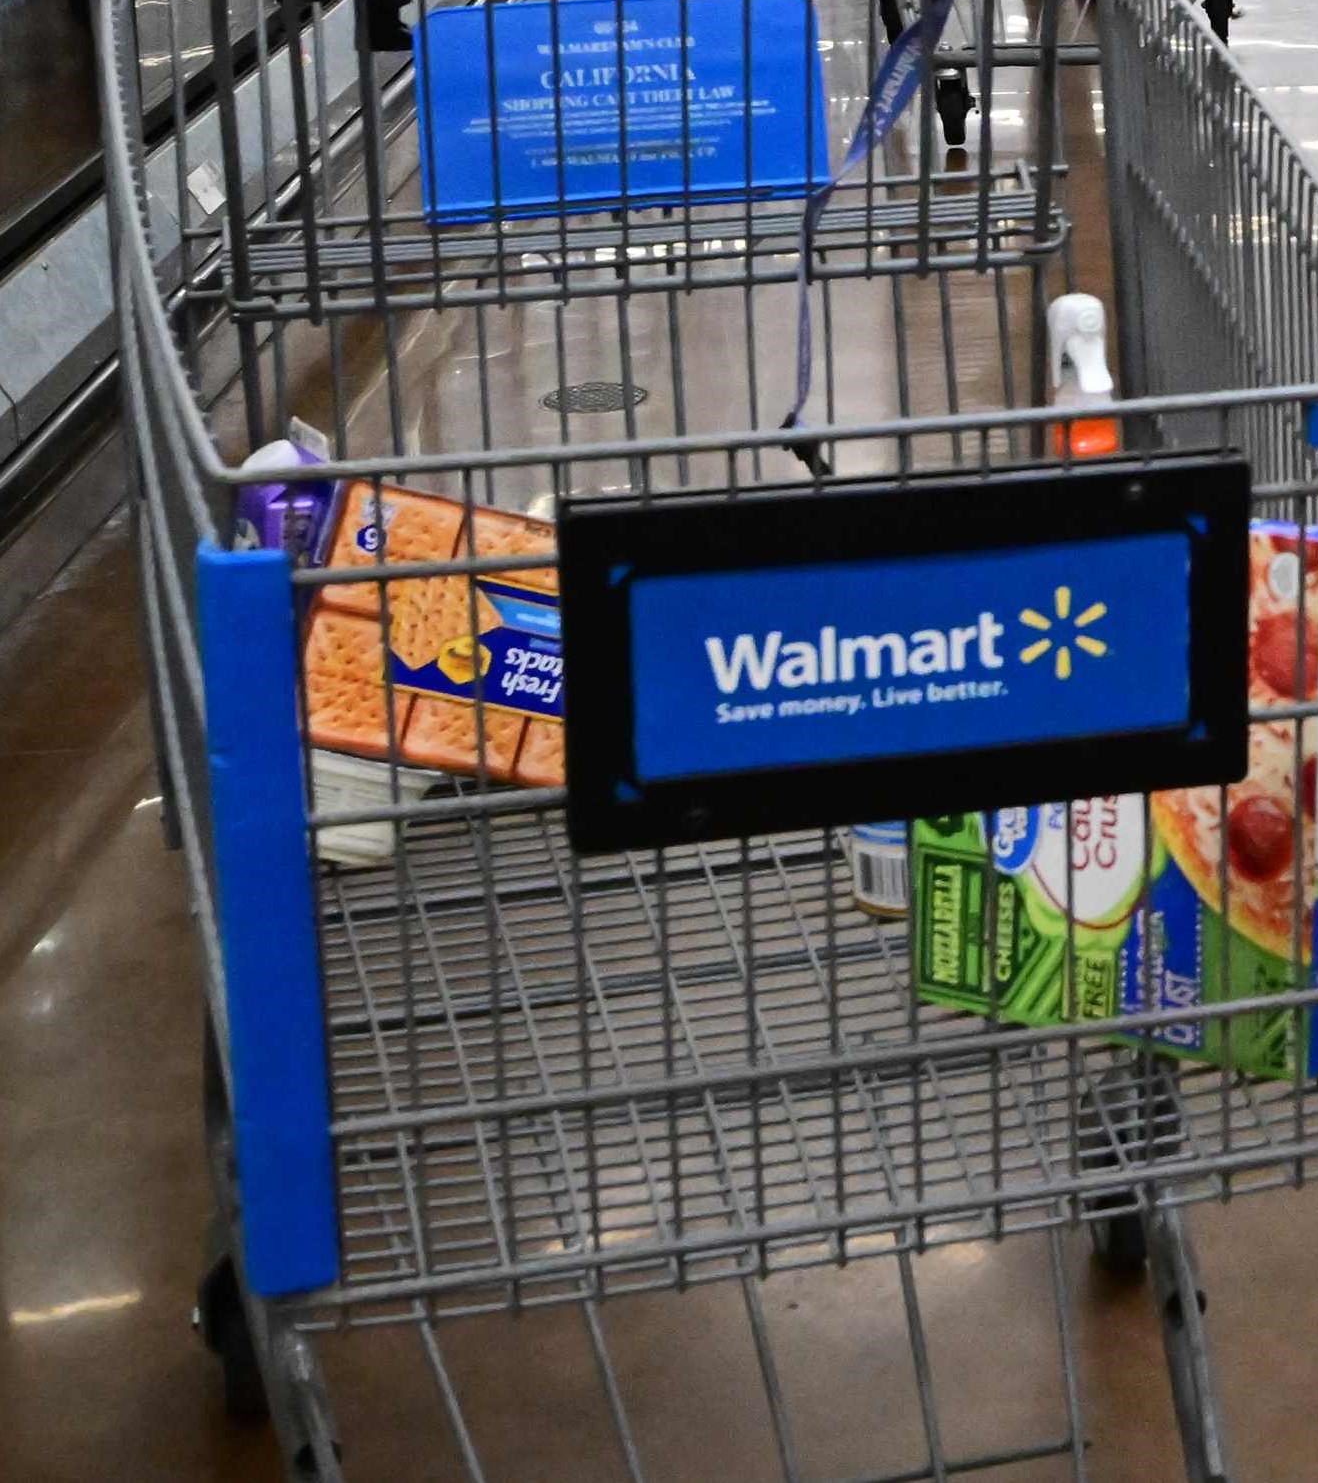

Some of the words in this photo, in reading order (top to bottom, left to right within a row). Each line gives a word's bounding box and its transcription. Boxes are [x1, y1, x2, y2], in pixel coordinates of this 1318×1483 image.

[593, 92, 635, 107] CAT
[505, 648, 566, 678] tacks
[705, 611, 1004, 694] Walmart
[501, 669, 561, 704] Fresh
[716, 699, 774, 723] Save
[778, 692, 867, 716] money.
[872, 685, 923, 709] Live
[926, 679, 1010, 704] better.
[1095, 795, 1118, 869] Crus
[932, 864, 963, 985] MOZZARELLA
[995, 881, 1016, 983] CHEESES
